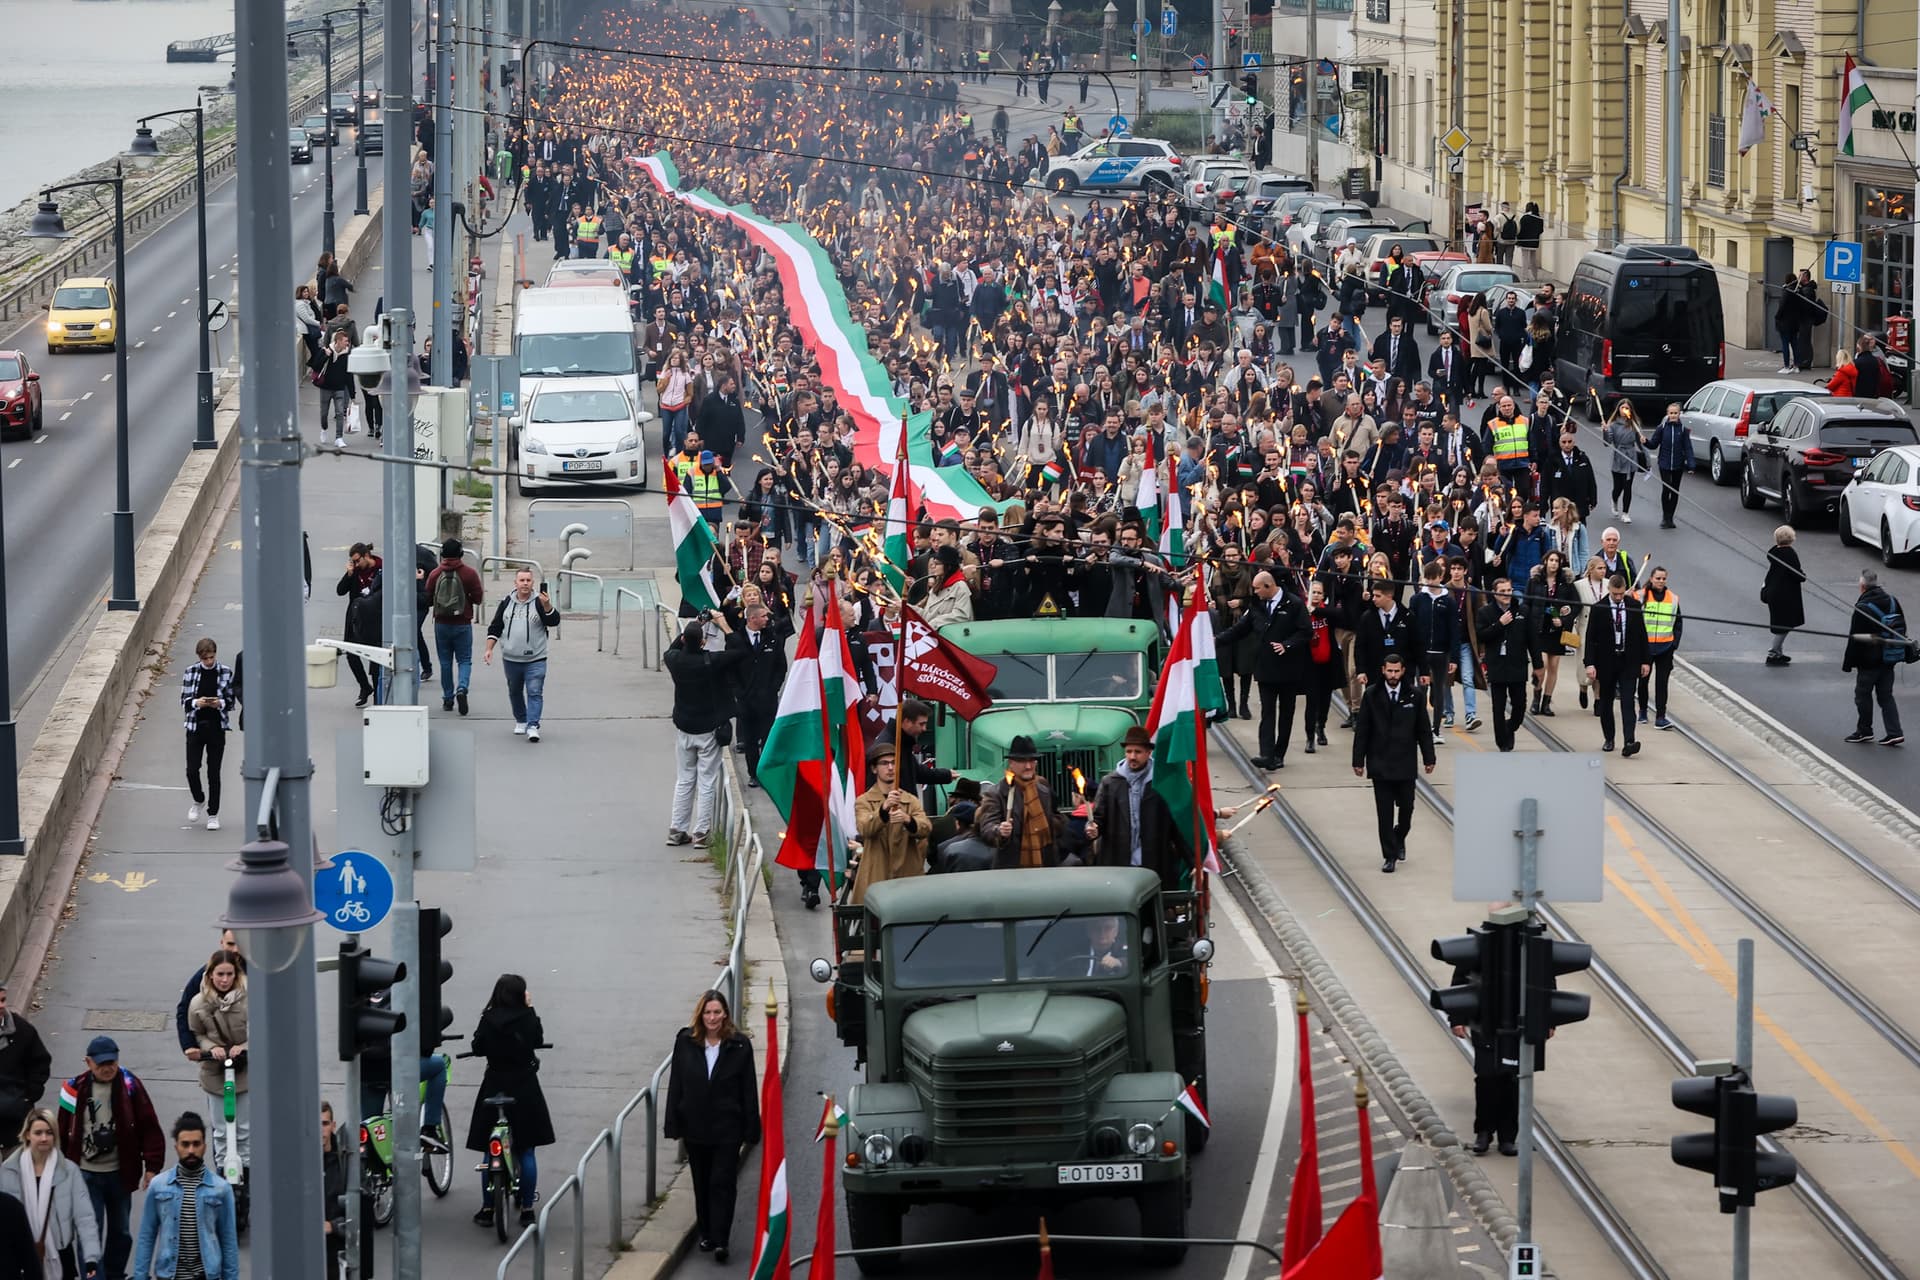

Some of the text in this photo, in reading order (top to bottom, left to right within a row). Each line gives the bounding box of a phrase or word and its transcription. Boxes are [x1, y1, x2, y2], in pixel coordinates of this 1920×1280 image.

[1833, 247, 1853, 276] P
[917, 673, 971, 700] SZÖVETSÉG
[920, 663, 965, 686] RÁKÓCZI
